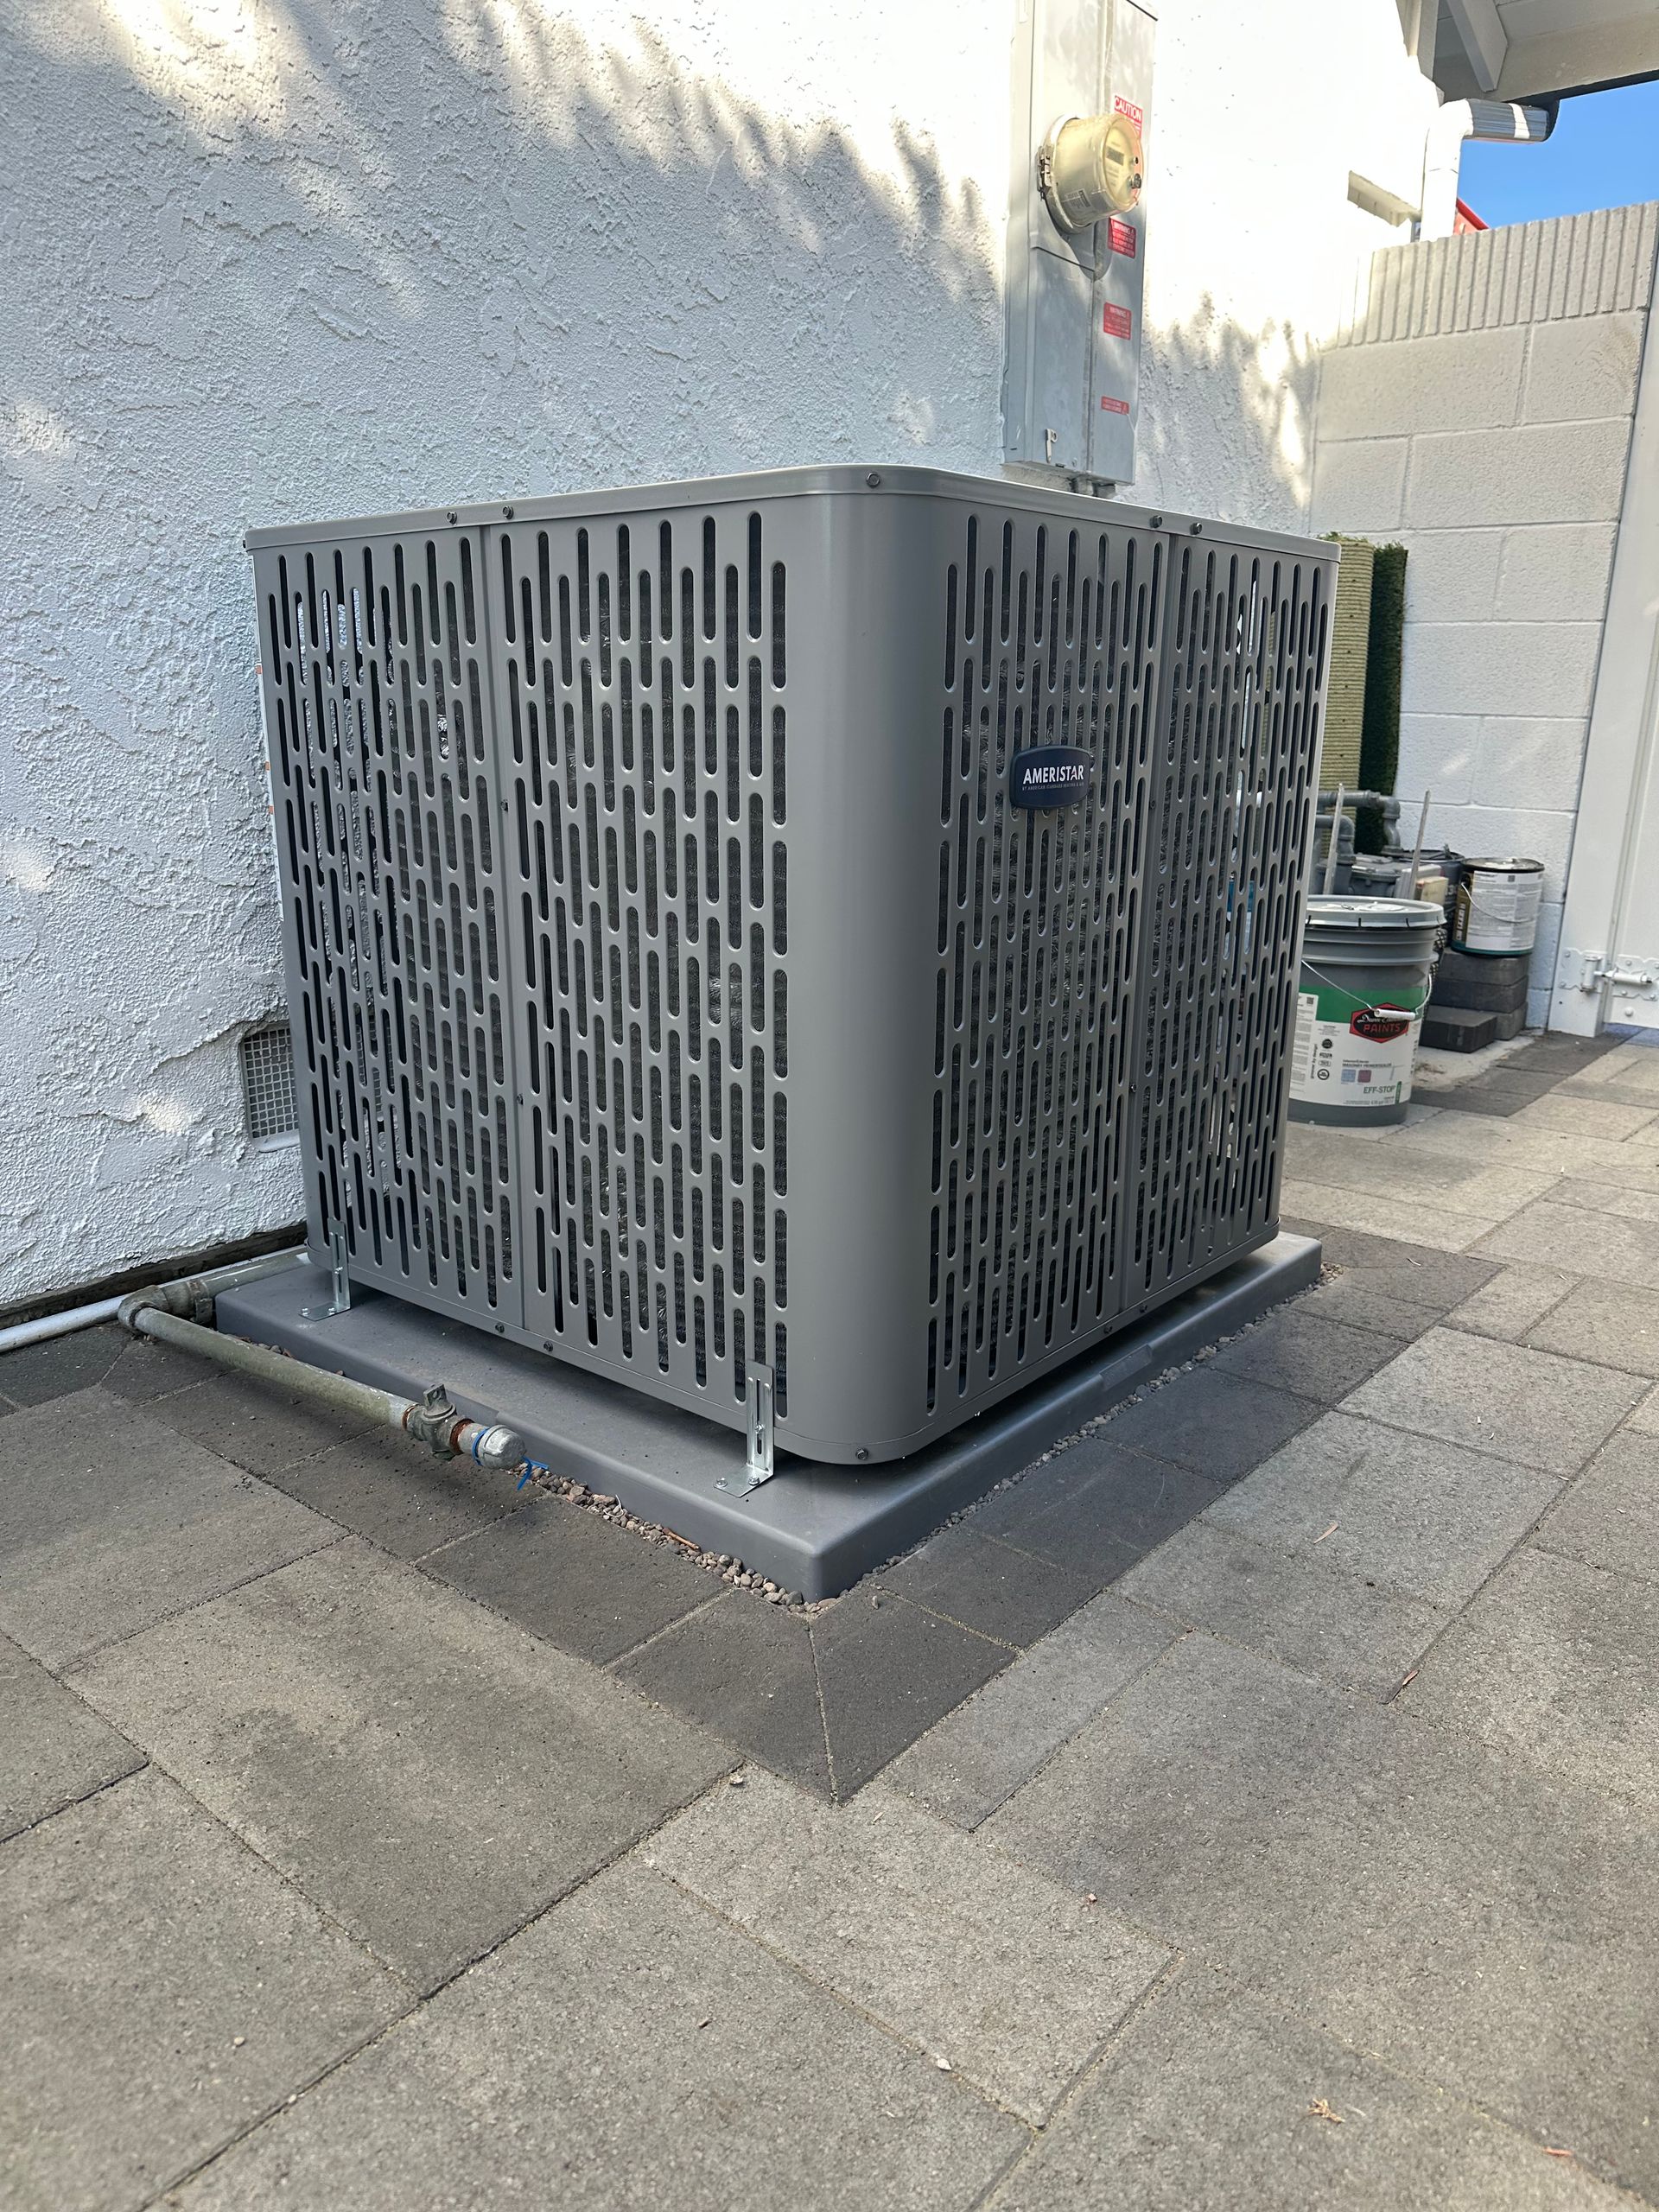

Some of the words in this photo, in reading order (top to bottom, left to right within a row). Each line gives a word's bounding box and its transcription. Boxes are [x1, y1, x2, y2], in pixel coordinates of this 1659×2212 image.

[1115, 98, 1141, 121] CAUTION
[1023, 765, 1084, 785] AMERISTAR
[1363, 1023, 1401, 1033] PAINTS
[1363, 1085, 1395, 1094] EFF-STOP
